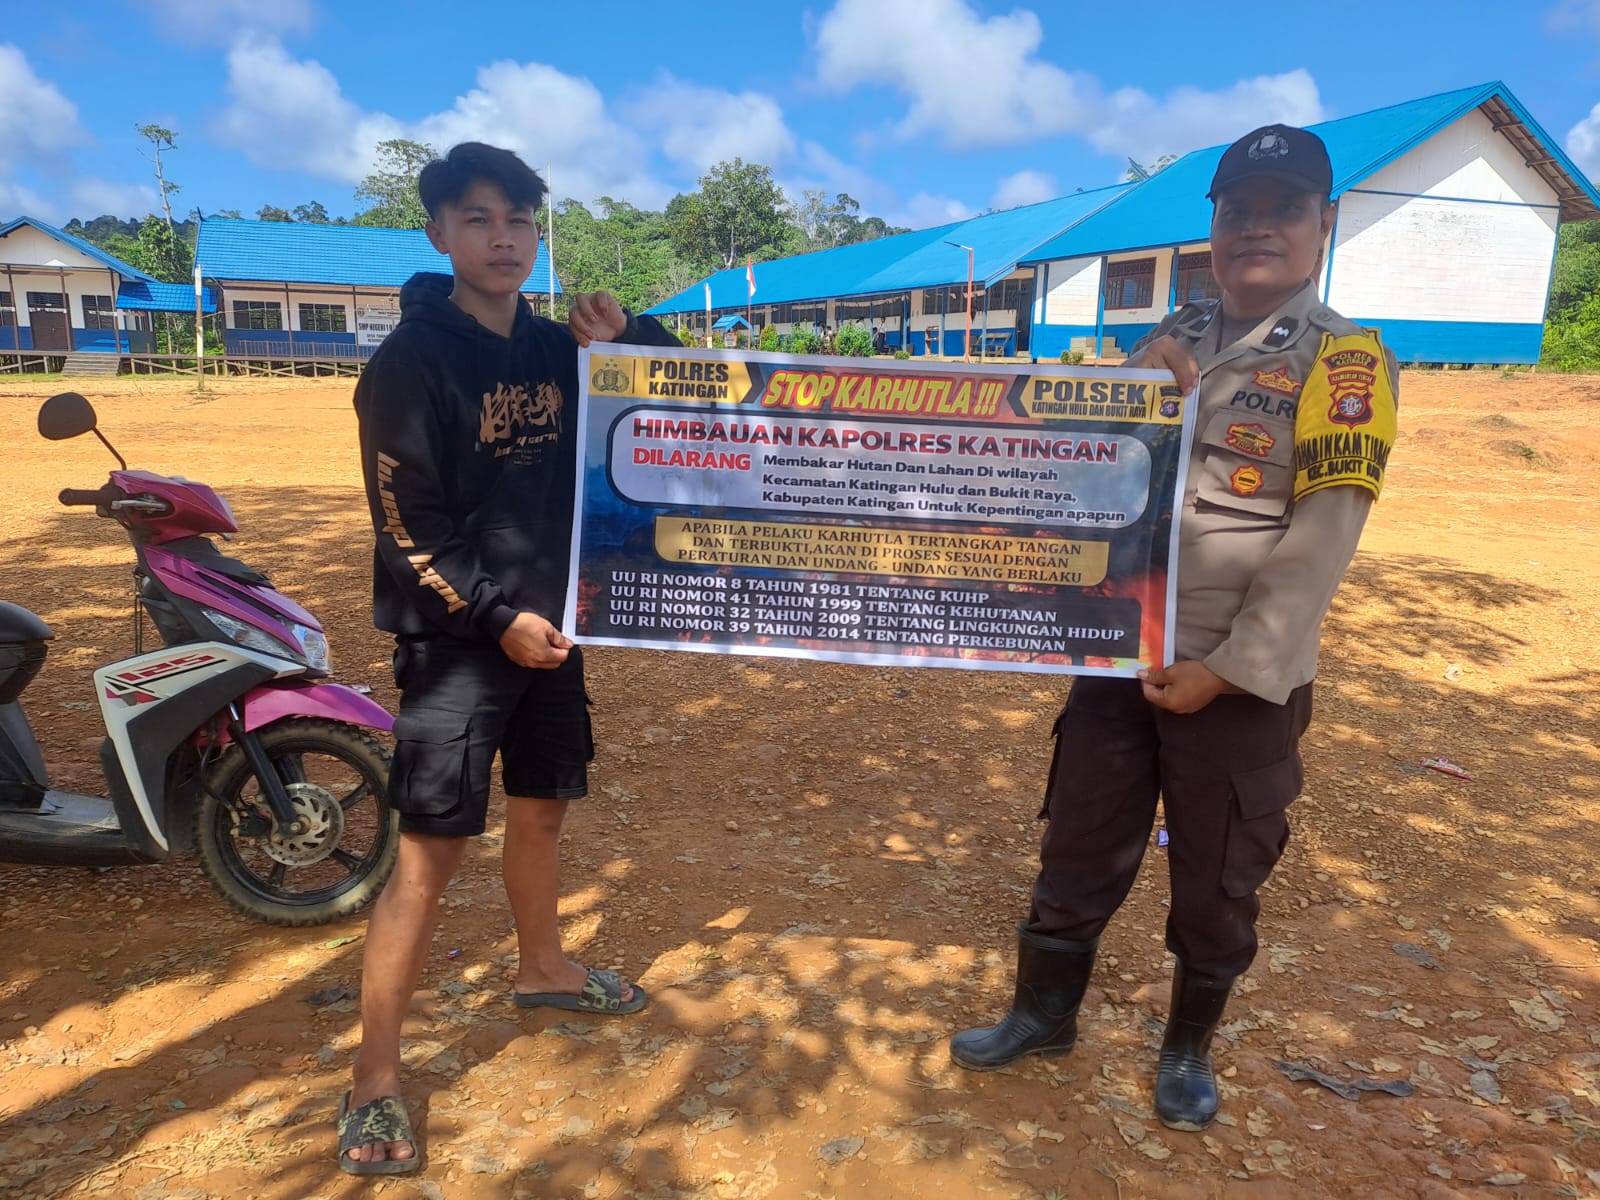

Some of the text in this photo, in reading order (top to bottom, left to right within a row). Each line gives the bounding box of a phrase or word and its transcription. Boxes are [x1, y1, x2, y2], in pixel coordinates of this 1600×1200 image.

[650, 360, 729, 382] POLRES
[649, 381, 728, 399] KATINGAN
[763, 372, 1004, 415] STOP KARHUTLA !!!
[1034, 380, 1148, 405] POLSEK
[1032, 402, 1146, 418] KATINGAN HULU DAN BUKIT RAYA
[632, 417, 1118, 462] HIMBAUAN KAPOLRES KATINGAN
[633, 448, 1058, 482] DILARANG Membakar Hutan Dan Lahan Di wilayah
[763, 474, 1077, 503] Kecamatan Katingan Hulu dan Bukit Raya,
[762, 491, 1126, 524] Kabupaten Katingan Untuk Kepentingan apapun
[681, 522, 1082, 556] APABILA PELAKU KARHUTLA TERTANGKAP TANGAN
[692, 536, 724, 549] DAN
[861, 546, 878, 557] DI
[882, 548, 940, 562] PROSES
[944, 550, 998, 565] SESUAI
[1002, 554, 1069, 569] DENGAN
[678, 549, 772, 565] PERATURAN
[776, 554, 809, 567] DAN
[813, 557, 878, 572] UNDANG
[892, 562, 958, 576] UNDANG
[962, 566, 1004, 580] YANG
[1008, 568, 1082, 584] BERLAKU
[610, 586, 1057, 622] UU RI NOMOR 41 TAHUN 1999 TENTANG KEHUTANAN
[611, 571, 990, 604] UU RI NOMOR 8 TAHUN 1981 TENTANG KUHP
[609, 614, 1066, 652] UU RI NOMOR 39 TAHUN 2014 TENTANG PERKEBUNAN
[610, 600, 1126, 640] UU RI NOMOR 32 TAHUN 2009 TENTANG LINGKUNGAN HIDUP
[117, 653, 215, 682] 125
